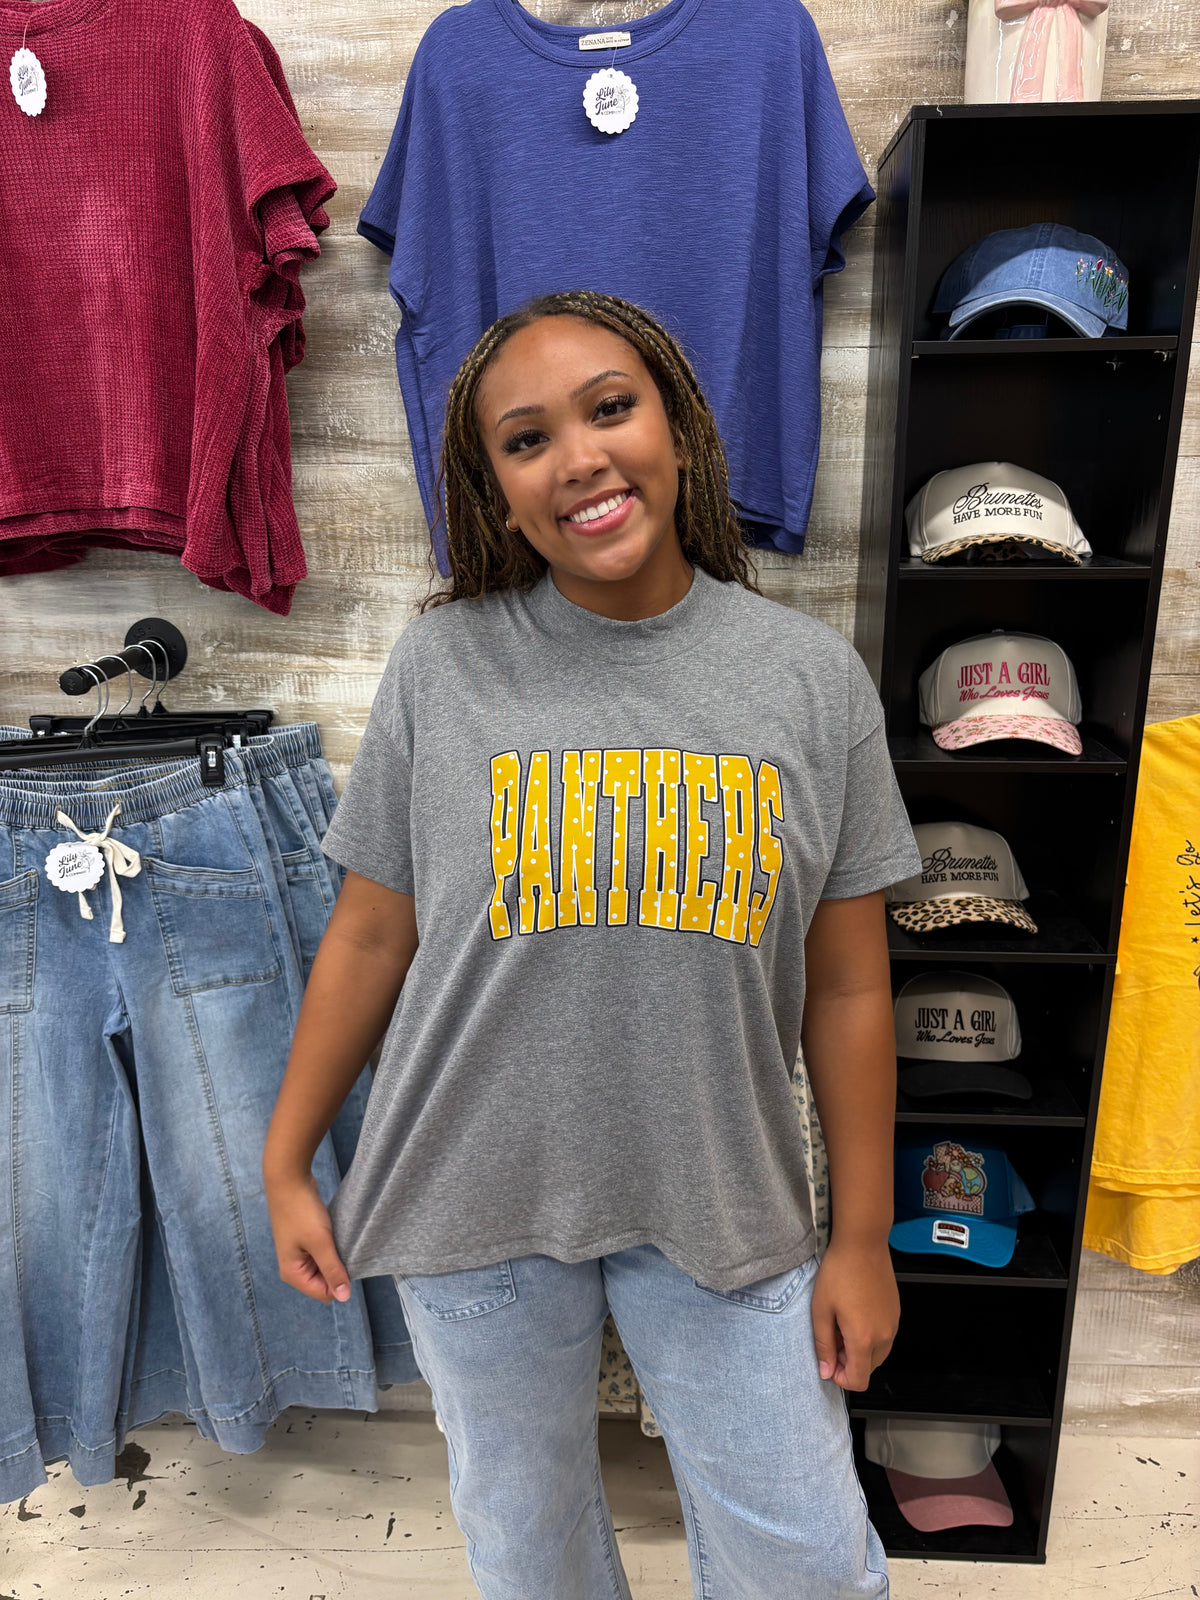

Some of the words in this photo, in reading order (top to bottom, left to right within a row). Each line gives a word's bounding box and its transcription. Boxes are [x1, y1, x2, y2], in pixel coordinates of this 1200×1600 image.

[595, 86, 614, 101] Lily
[595, 98, 618, 116] June
[952, 482, 1044, 515] Brunettes
[953, 509, 981, 525] HAVE
[984, 507, 1021, 518] MORE
[1023, 508, 1043, 521] FUN
[957, 662, 993, 689] JUST
[998, 661, 1011, 684] A
[1017, 662, 1051, 687] GIRL
[959, 687, 979, 702] Who
[979, 685, 1021, 699] Loves
[1022, 686, 1050, 702] Jesus
[488, 748, 785, 947] PANTHERS
[58, 853, 78, 867] Lily
[921, 846, 999, 875] Brunettes
[58, 861, 82, 879] June
[921, 872, 948, 884] HAVE
[951, 871, 982, 882] MORE
[983, 872, 999, 882] FUN
[914, 1007, 948, 1029] JUST
[953, 1009, 965, 1030] A
[970, 1010, 997, 1032] GIRL
[916, 1029, 936, 1043] Who
[936, 1030, 973, 1044] Loves
